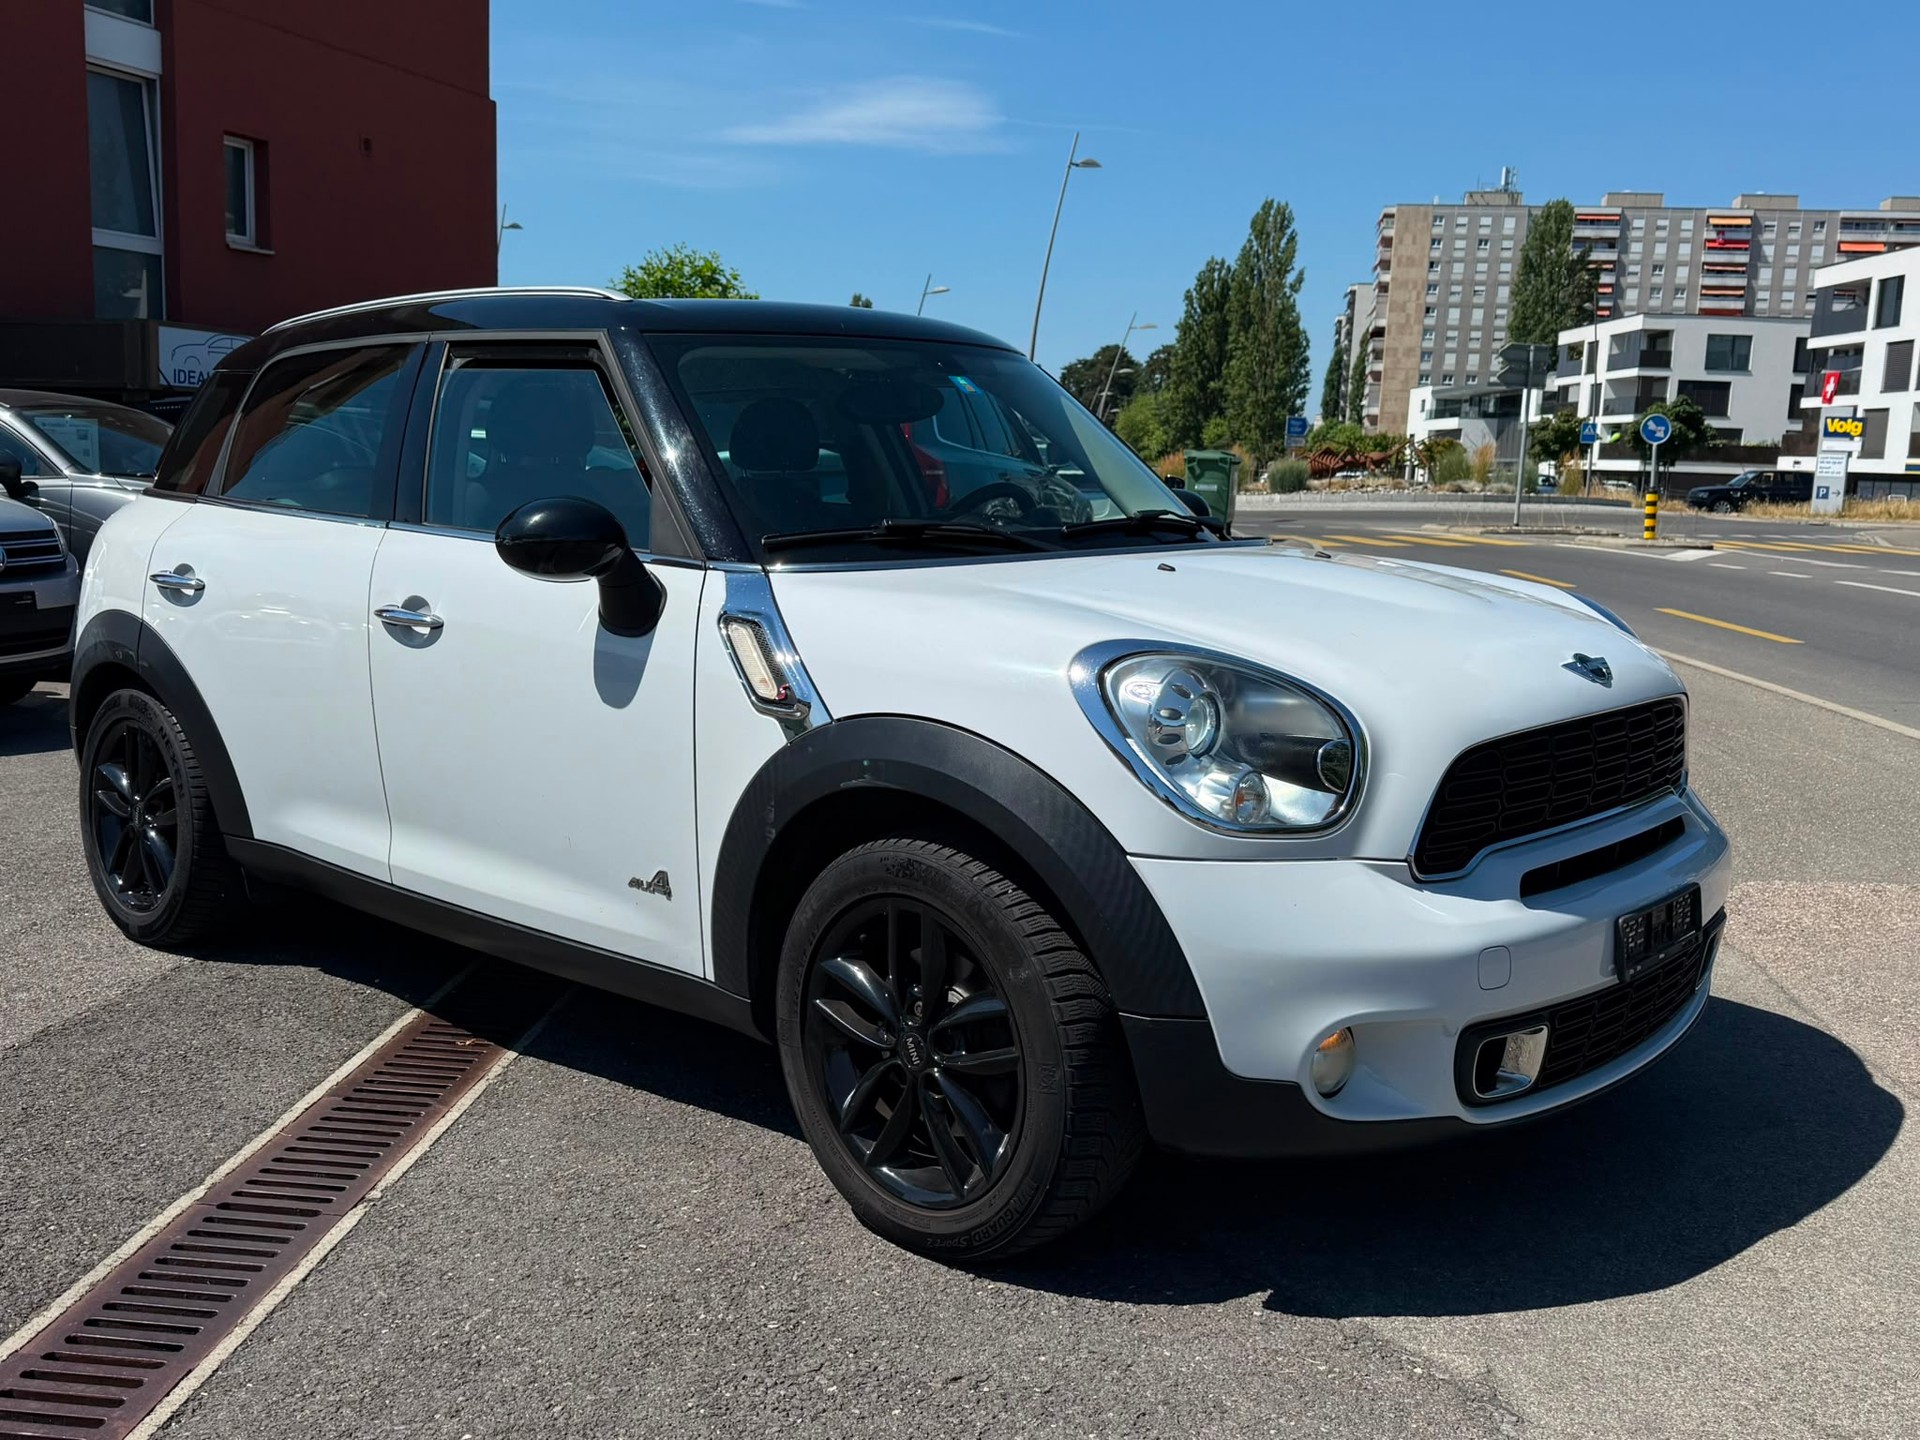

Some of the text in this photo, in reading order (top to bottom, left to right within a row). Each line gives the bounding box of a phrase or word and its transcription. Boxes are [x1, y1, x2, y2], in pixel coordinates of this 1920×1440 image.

[173, 368, 210, 385] IDEA
[1826, 418, 1863, 437] Volg
[1819, 487, 1827, 498] P
[906, 1037, 920, 1065] MINI
